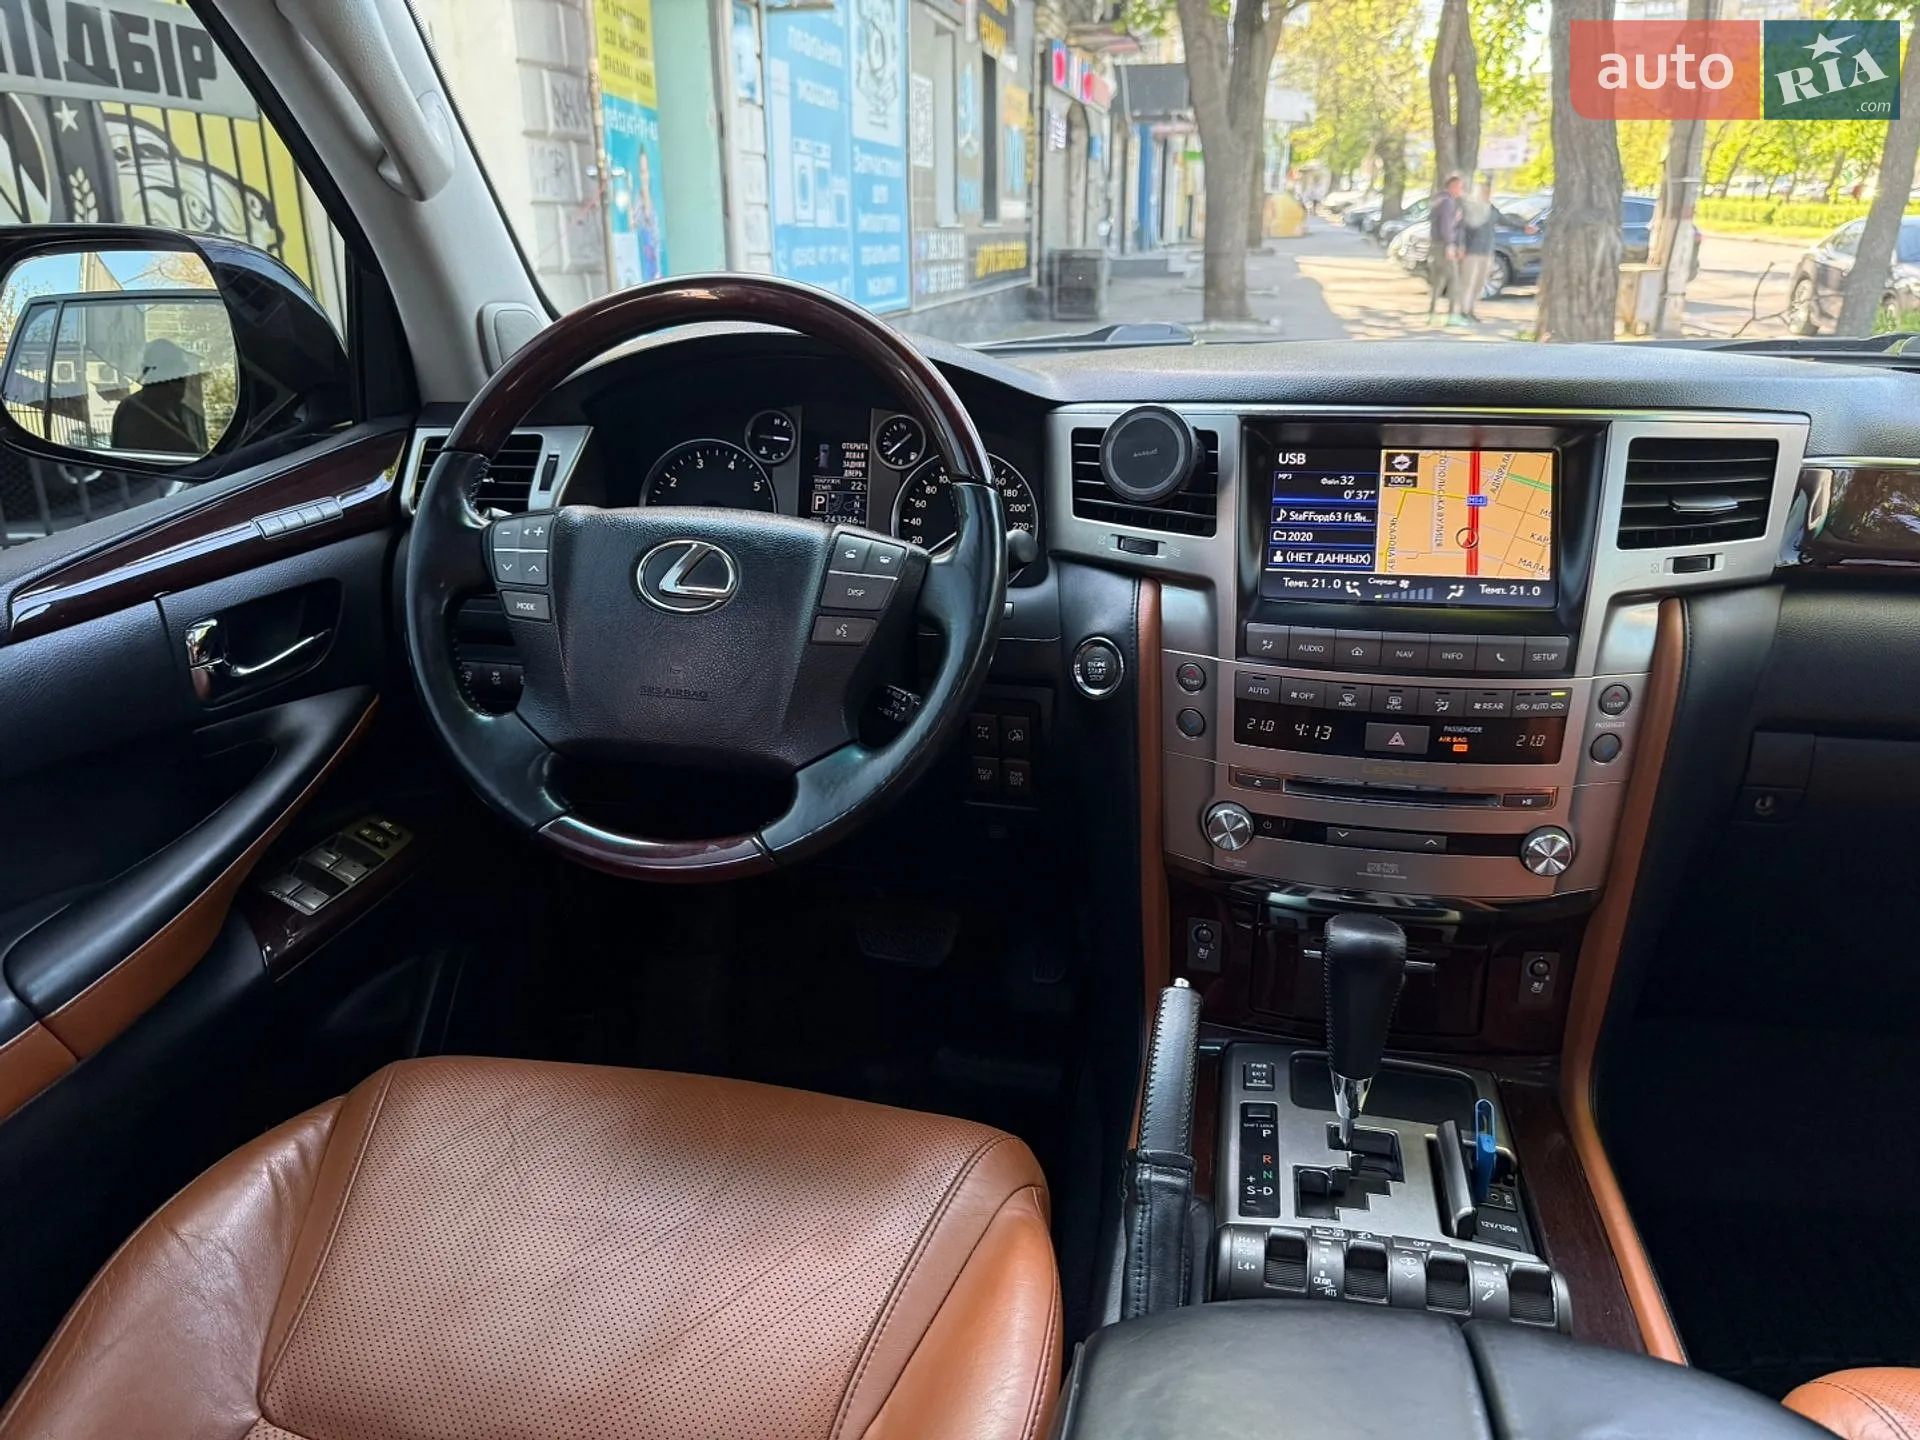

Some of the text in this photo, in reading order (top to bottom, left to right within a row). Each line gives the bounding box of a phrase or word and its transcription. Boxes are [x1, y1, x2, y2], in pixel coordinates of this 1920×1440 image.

[1278, 452, 1306, 465] USB
[696, 459, 704, 469] 3
[728, 460, 735, 470] 4
[669, 477, 677, 488] 2
[939, 475, 951, 484] 10
[1340, 475, 1355, 485] 32
[1390, 476, 1406, 484] 100
[753, 481, 760, 491] 5
[925, 486, 937, 494] 80
[1003, 489, 1018, 497] 180
[814, 495, 825, 510] P
[915, 500, 926, 508] 60
[1009, 504, 1026, 512] 200
[910, 518, 922, 526] 40
[1012, 523, 1028, 531] 220
[912, 536, 923, 544] 20
[1288, 532, 1313, 541] 2020
[1286, 551, 1371, 565] (НЕТ ДАННЫХ)
[1311, 578, 1341, 589] 21.0
[1509, 586, 1541, 597] 21.0
[1299, 644, 1324, 653] AUDIO
[1396, 650, 1414, 658] NAV
[1442, 652, 1463, 660] INFO
[1532, 653, 1557, 661] SETUP
[1248, 687, 1270, 696] AUTO
[1299, 692, 1316, 700] OFF
[1247, 718, 1275, 732] 21.0
[1294, 723, 1332, 741] 4:13
[1515, 734, 1546, 747] 21.0
[1262, 1129, 1271, 1137] P
[1263, 1155, 1272, 1164] R
[1263, 1171, 1273, 1179] N
